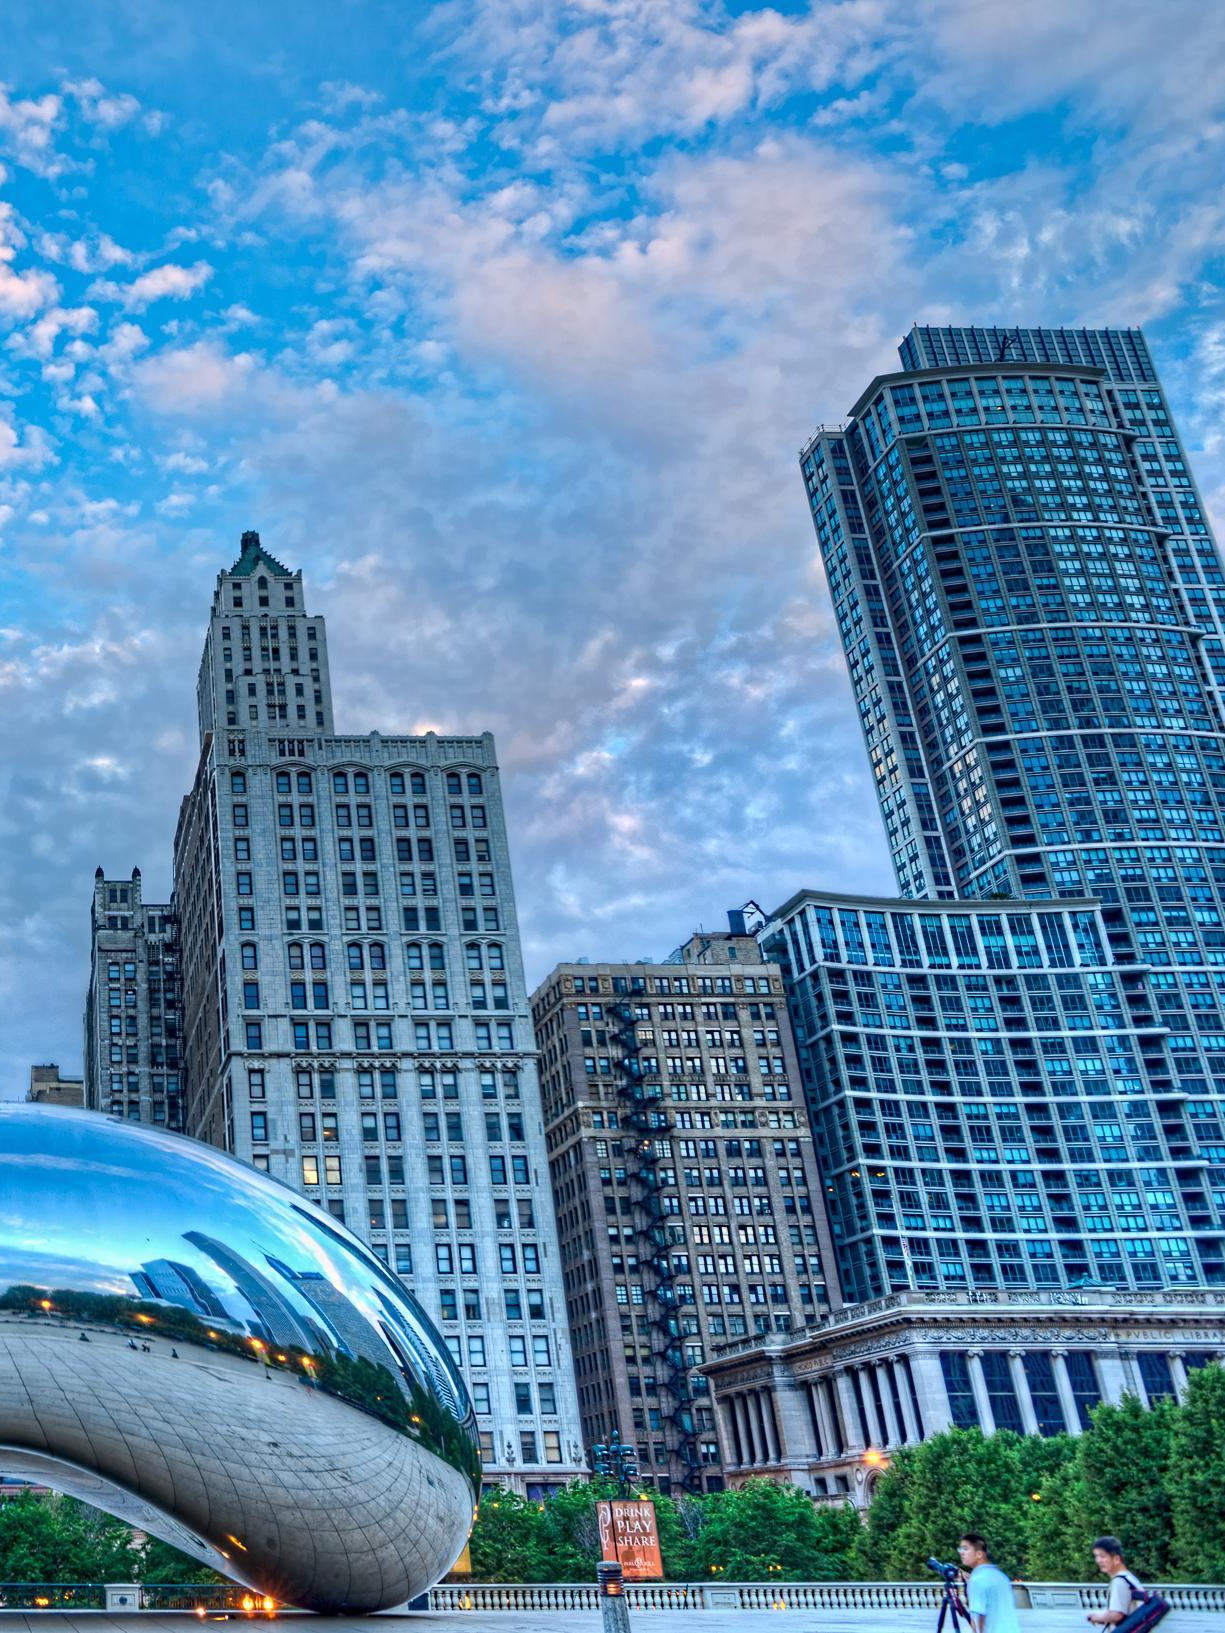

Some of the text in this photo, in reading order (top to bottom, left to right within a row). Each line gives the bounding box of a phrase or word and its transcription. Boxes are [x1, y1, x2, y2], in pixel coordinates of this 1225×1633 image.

[616, 1508, 651, 1517] DRINK
[617, 1521, 652, 1532] PLAY
[617, 1536, 656, 1546] SHARE
